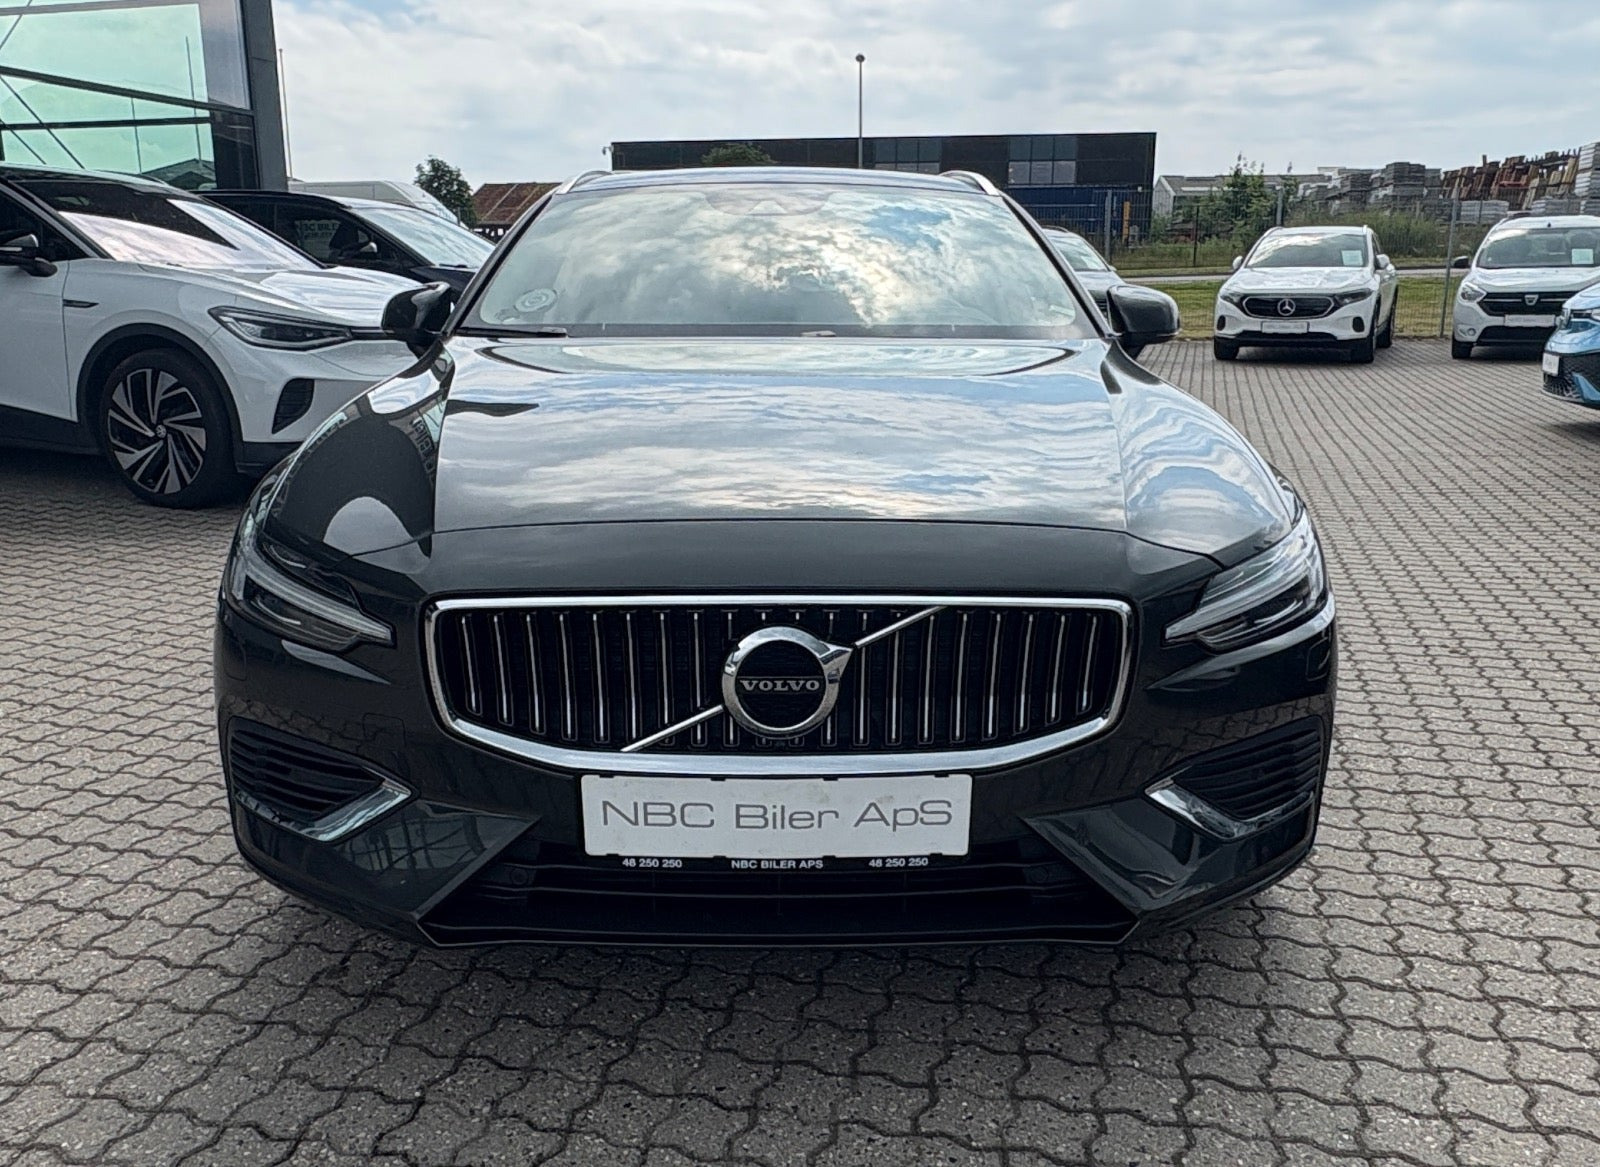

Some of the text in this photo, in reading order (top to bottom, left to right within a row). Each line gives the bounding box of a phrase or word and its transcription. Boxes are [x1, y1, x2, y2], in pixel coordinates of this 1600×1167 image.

[739, 679, 820, 692] VOLVO
[602, 800, 953, 833] NBC Biler ApS
[621, 857, 683, 869] 48 250 250
[731, 859, 824, 870] NBC BILER APS
[868, 856, 929, 868] 48 250 250
